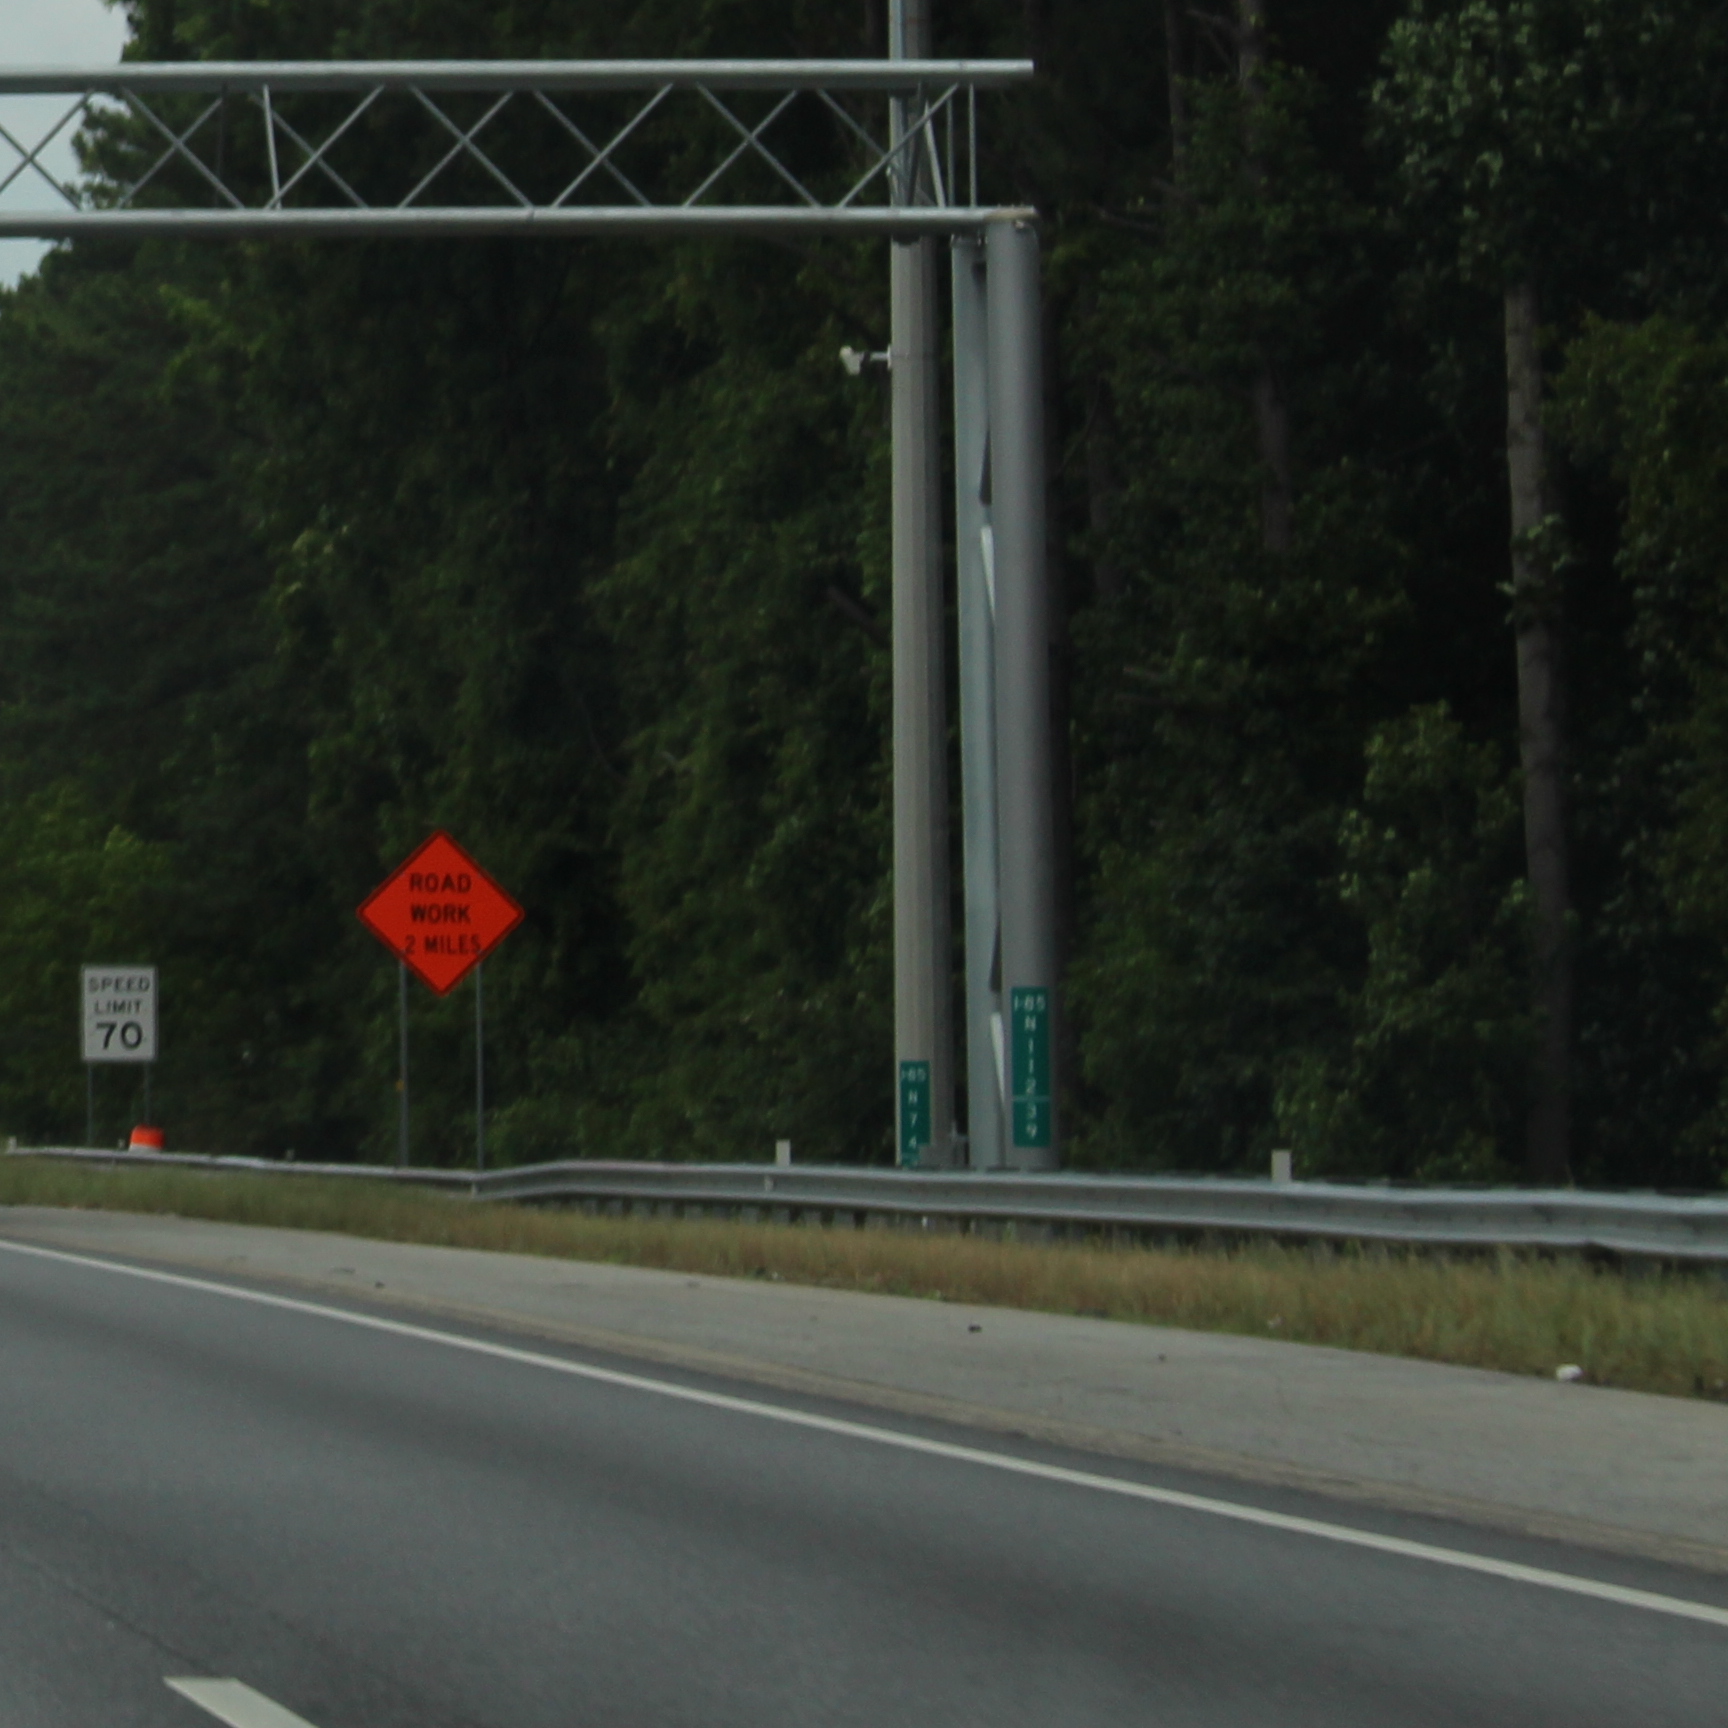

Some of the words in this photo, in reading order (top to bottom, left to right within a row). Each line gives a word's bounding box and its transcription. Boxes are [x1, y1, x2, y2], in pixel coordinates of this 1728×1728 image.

[409, 873, 472, 893] ROAD
[411, 905, 471, 922] WORK
[405, 935, 415, 954] 2
[425, 935, 480, 955] MILES
[89, 976, 150, 992] SPEED
[94, 999, 142, 1014] LIMIT
[96, 1020, 143, 1050] 70
